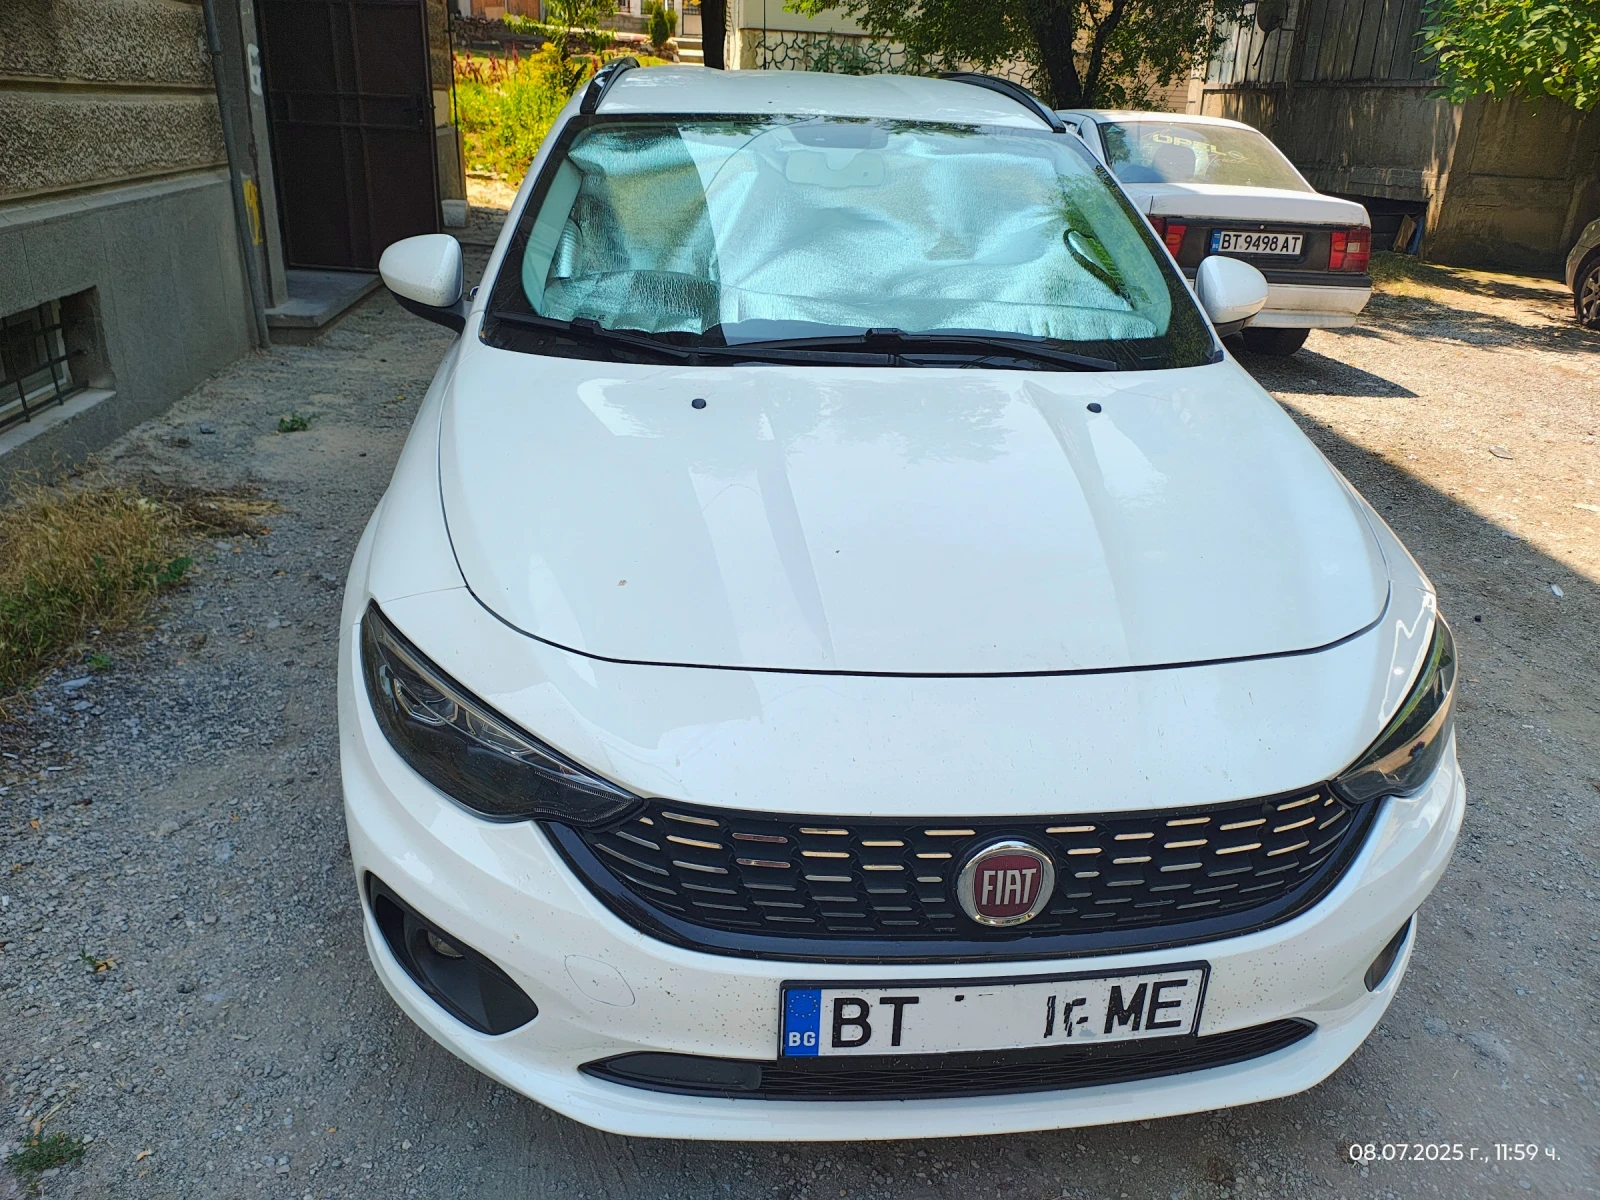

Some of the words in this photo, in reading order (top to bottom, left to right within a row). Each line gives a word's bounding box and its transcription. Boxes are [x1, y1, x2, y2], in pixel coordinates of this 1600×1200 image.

[1152, 133, 1227, 156] OPEL
[1221, 234, 1242, 250] BT
[1244, 235, 1278, 251] 9498
[1280, 237, 1300, 252] AT
[981, 868, 1037, 905] FIAT
[832, 996, 919, 1048] BT
[1103, 979, 1188, 1034] ME
[788, 1031, 816, 1047] BG
